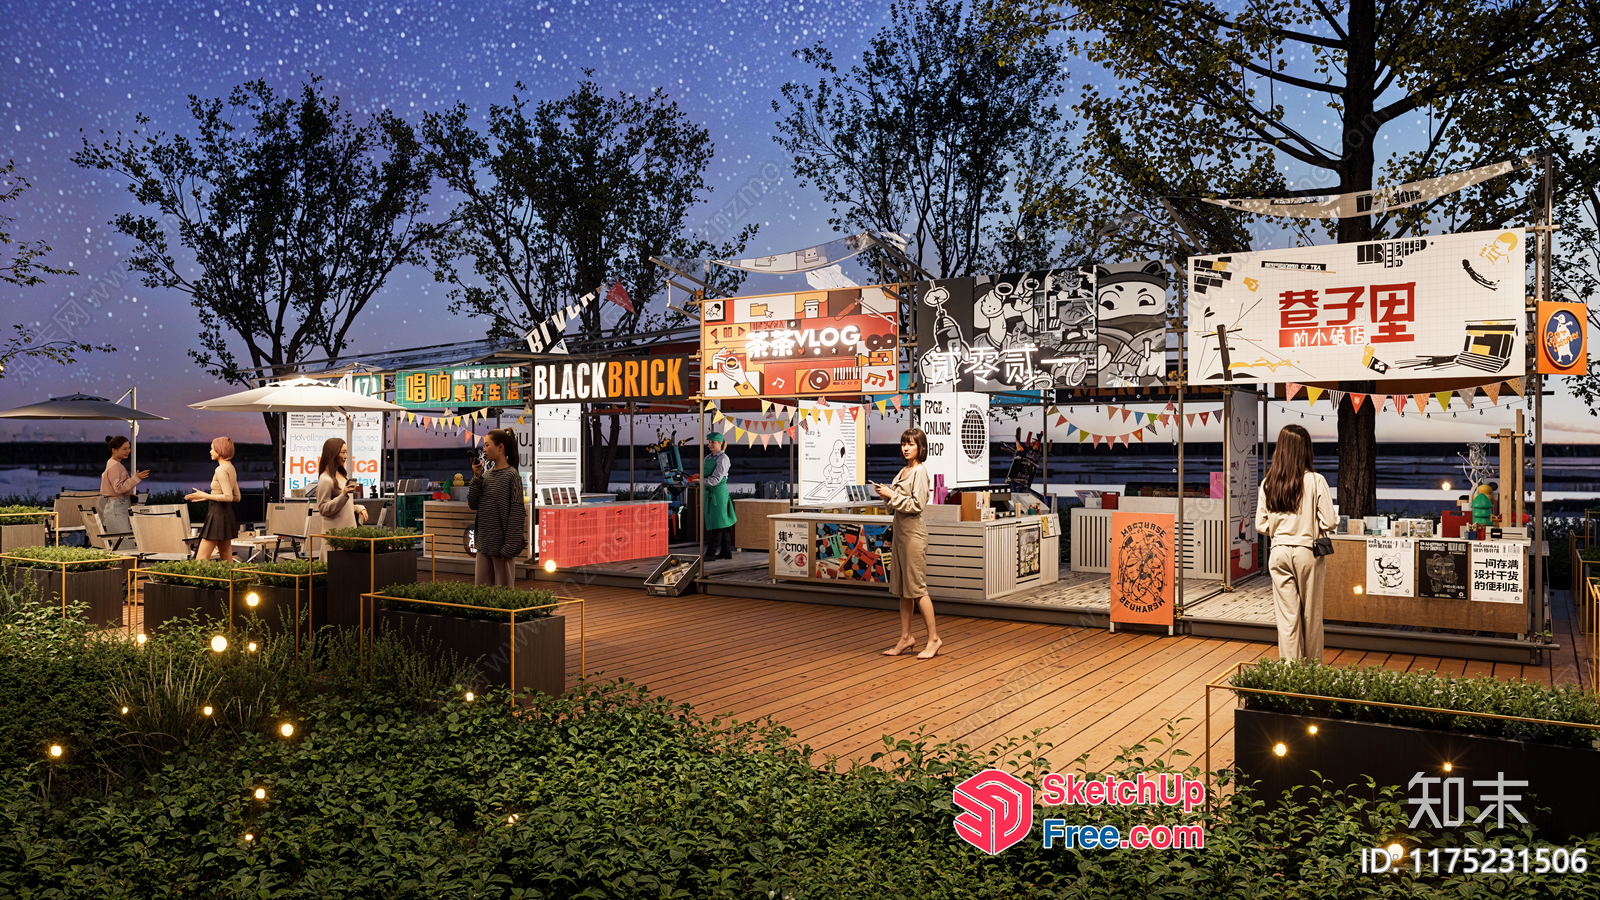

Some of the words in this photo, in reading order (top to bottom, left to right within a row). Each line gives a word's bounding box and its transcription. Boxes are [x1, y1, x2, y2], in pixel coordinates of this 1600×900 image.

[406, 371, 451, 403] 唱响
[534, 358, 683, 400] BLACKBRICK
[928, 443, 944, 456] HOP
[289, 456, 378, 475] Helica
[1474, 558, 1519, 569] 一间存满
[1474, 569, 1519, 581] 设计干货
